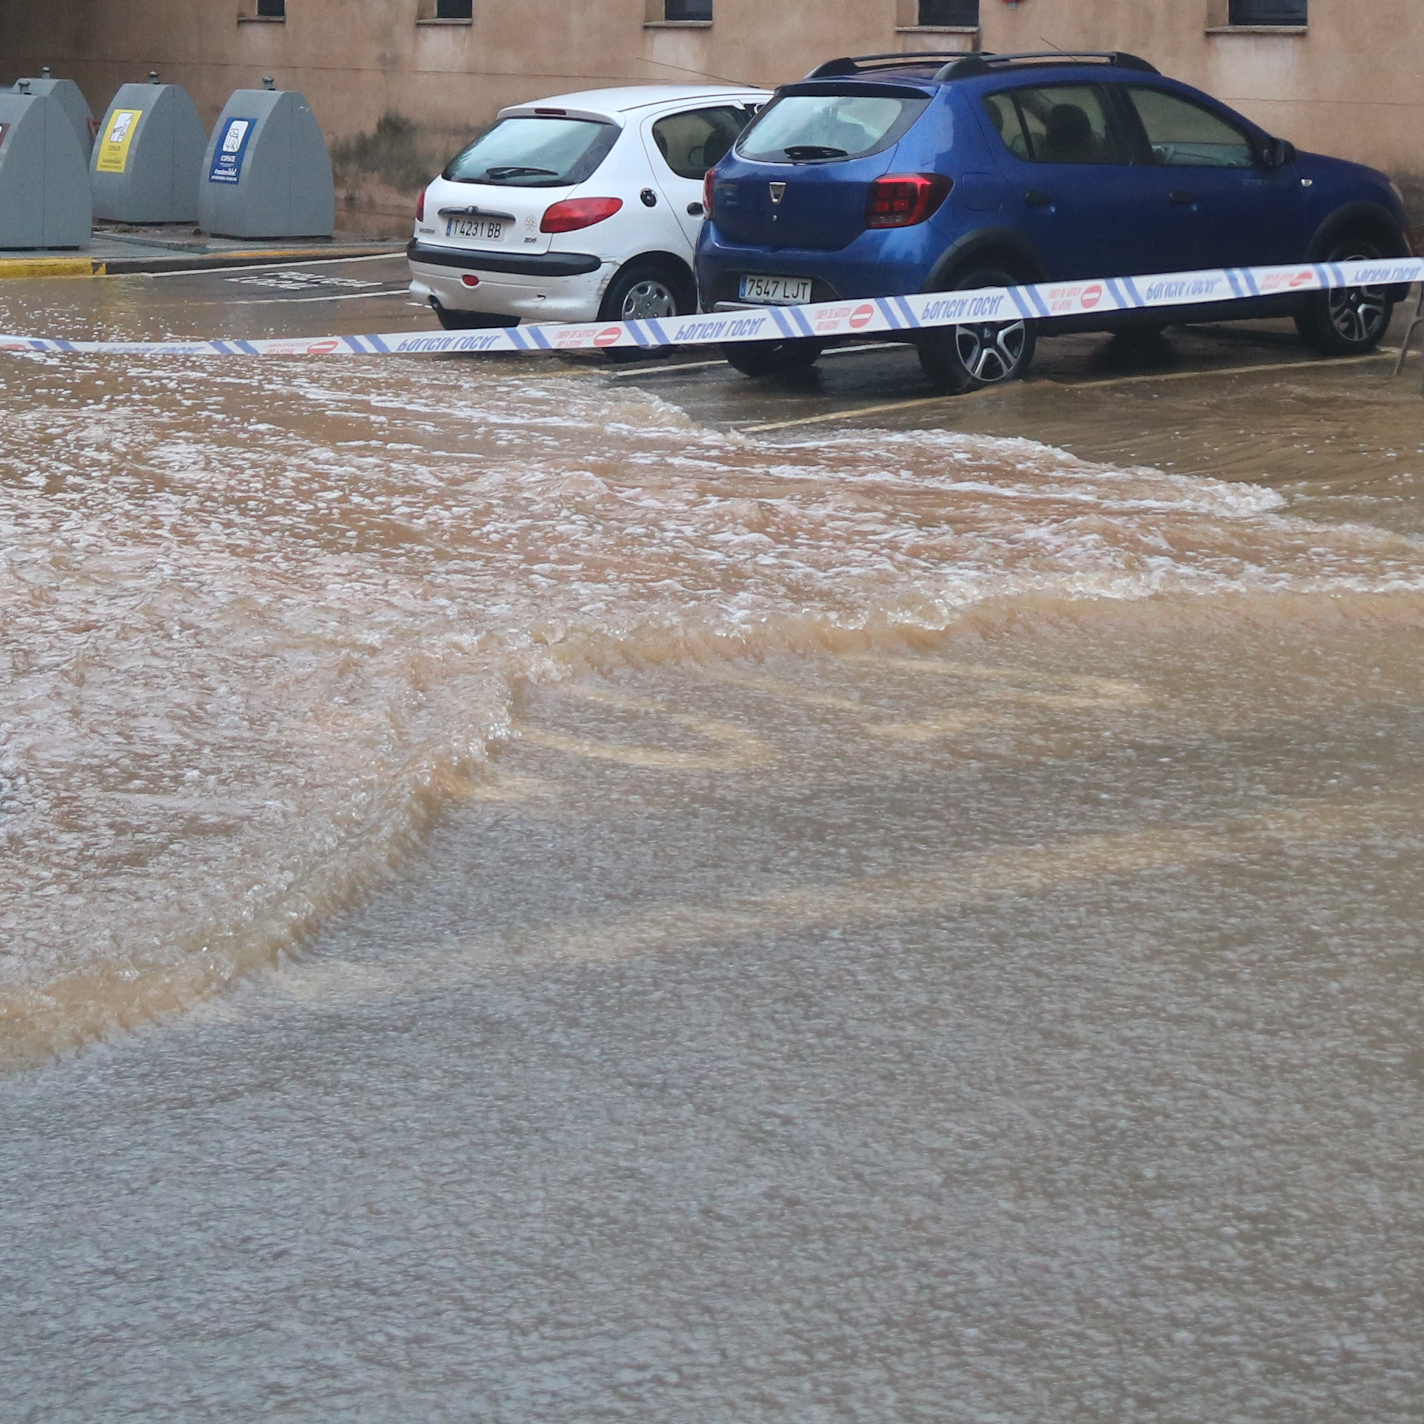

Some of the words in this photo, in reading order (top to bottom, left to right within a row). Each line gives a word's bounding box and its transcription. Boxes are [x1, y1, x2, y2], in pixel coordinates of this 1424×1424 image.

[460, 221, 484, 237] 4231
[487, 222, 502, 238] BB
[747, 279, 780, 298] 7547
[783, 280, 809, 299] LJT
